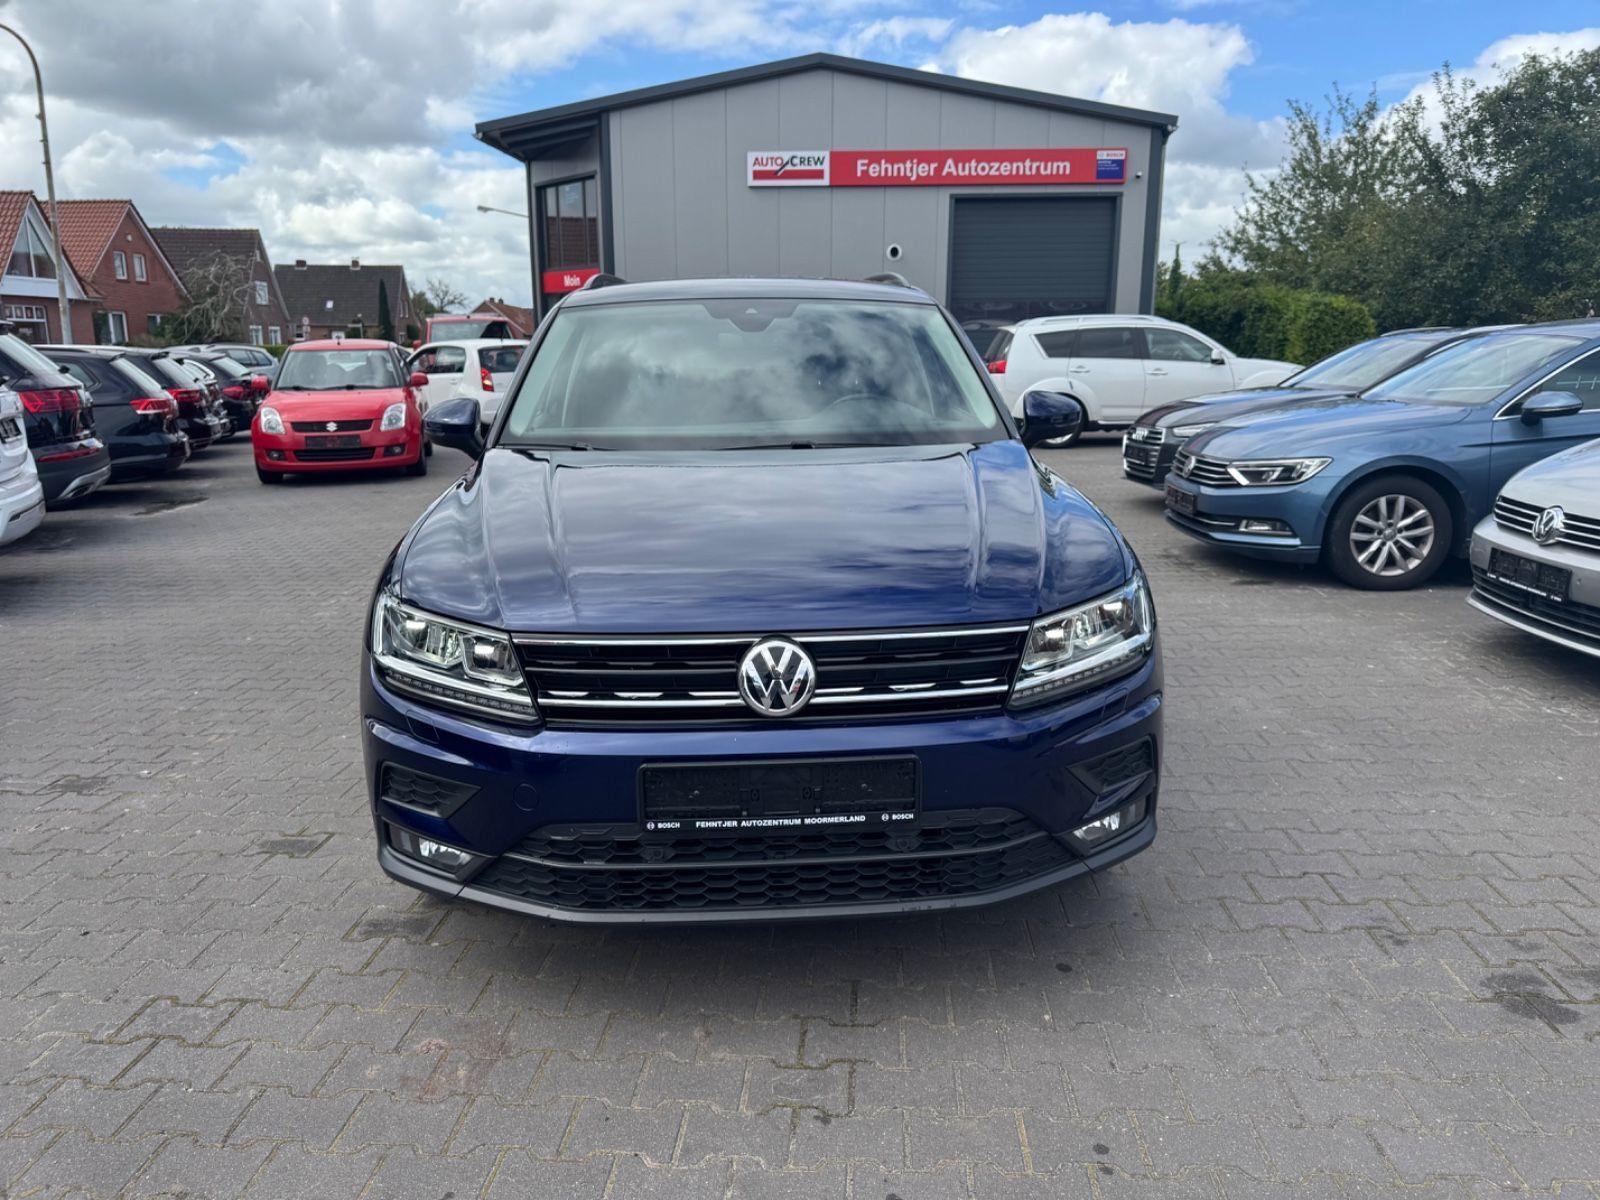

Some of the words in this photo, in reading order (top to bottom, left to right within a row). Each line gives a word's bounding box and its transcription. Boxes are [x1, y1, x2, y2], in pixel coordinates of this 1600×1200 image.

[752, 156, 784, 167] AUTO
[789, 155, 826, 167] CREW
[856, 159, 939, 181] Fehntjer
[941, 158, 1071, 177] Autozentrum
[563, 274, 581, 287] Moin
[657, 821, 681, 829] BOSCH
[695, 820, 739, 828] FEHNTJER
[740, 818, 802, 828] AUTOZENTRUM
[803, 815, 866, 825] MOORMERLAND
[891, 812, 914, 820] BOSCH
